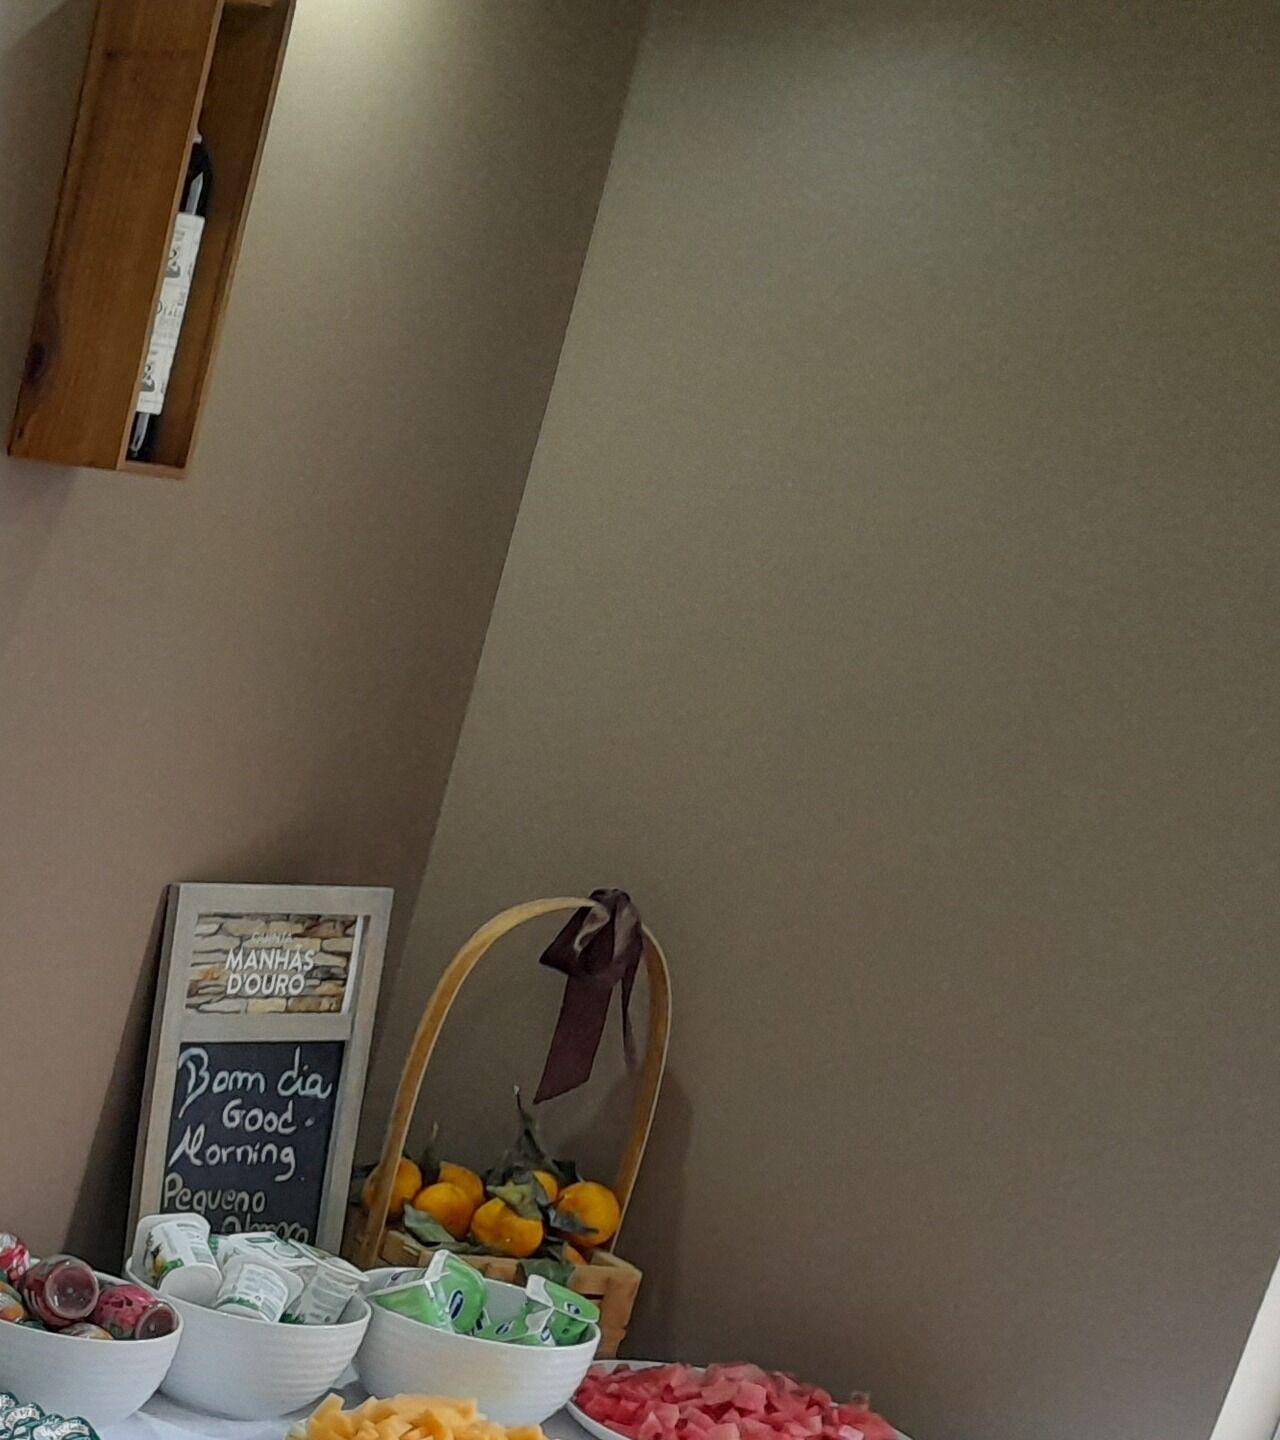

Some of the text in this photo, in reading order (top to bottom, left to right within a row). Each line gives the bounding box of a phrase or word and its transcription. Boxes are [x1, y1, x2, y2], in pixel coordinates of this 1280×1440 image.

[226, 973, 305, 996] D'OURO
[177, 1046, 332, 1118] Bom dia
[223, 1098, 296, 1135] Good
[163, 1171, 266, 1214] Pequeno
